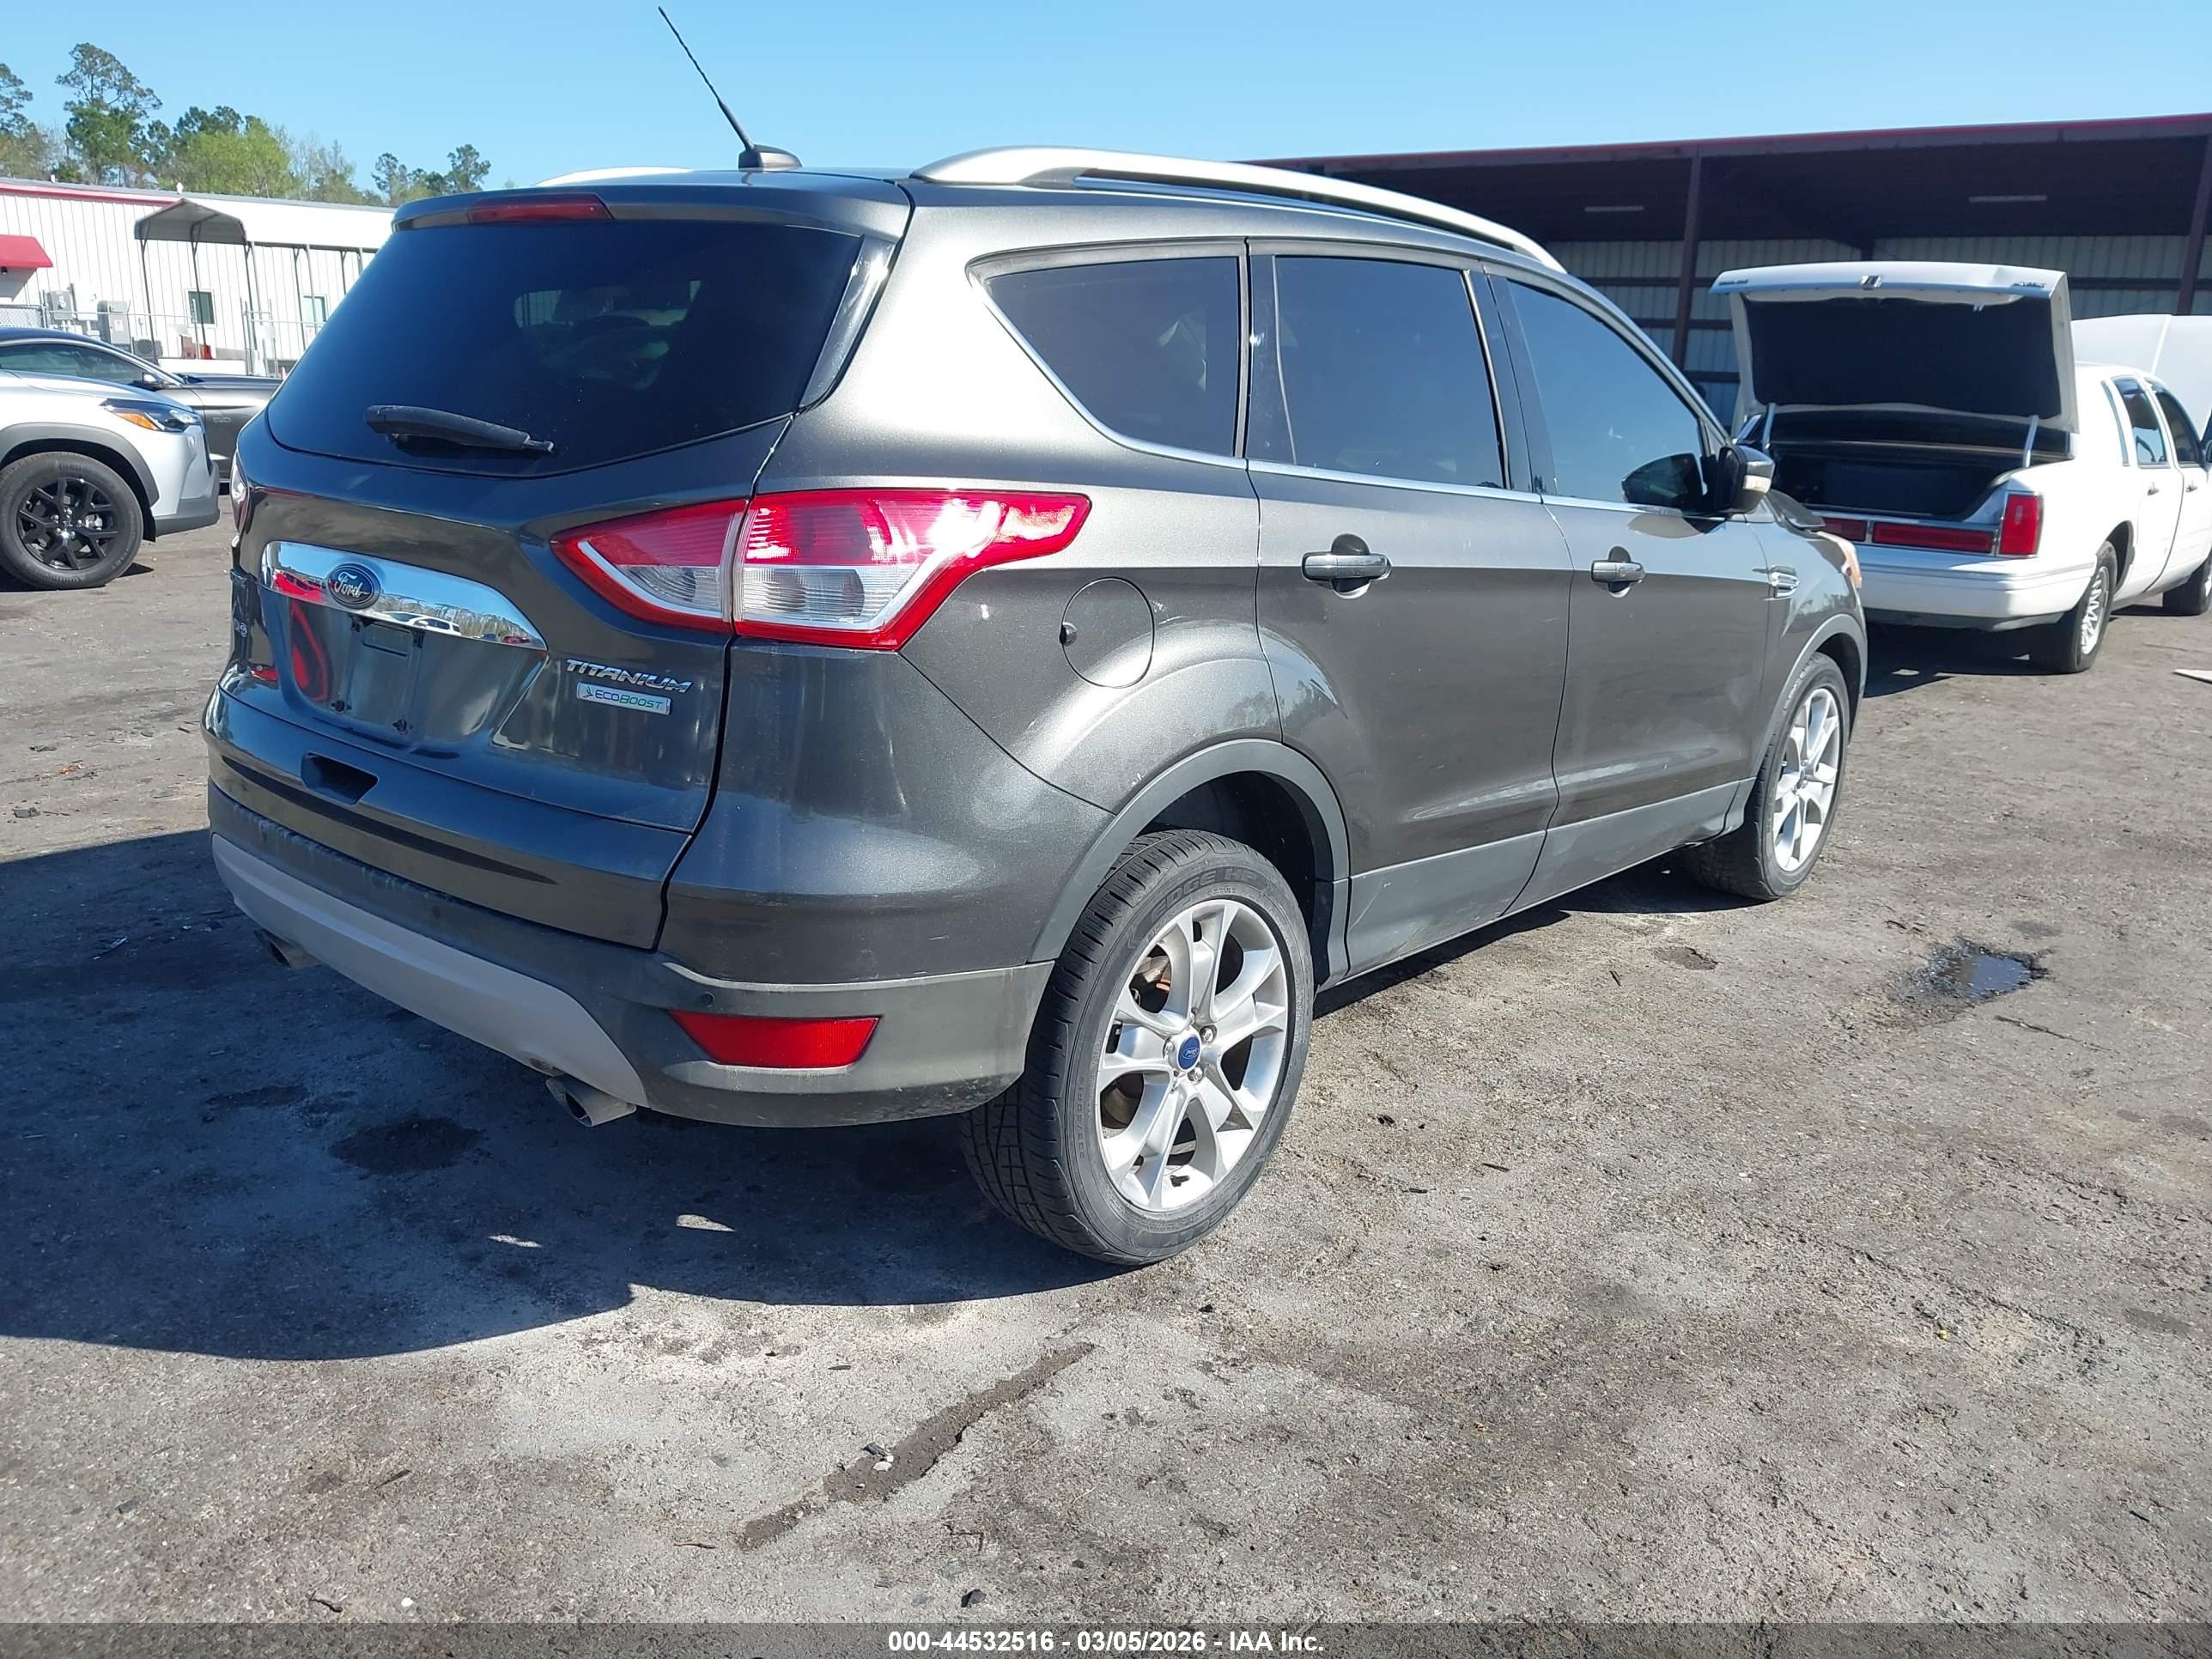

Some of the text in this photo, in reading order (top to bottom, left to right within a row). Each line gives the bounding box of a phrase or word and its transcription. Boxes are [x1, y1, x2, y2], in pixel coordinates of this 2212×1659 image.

[334, 571, 370, 599] Ford
[566, 659, 694, 693] TITANIUM
[594, 690, 664, 709] ECOBOOST
[1149, 869, 1218, 927] EDGE
